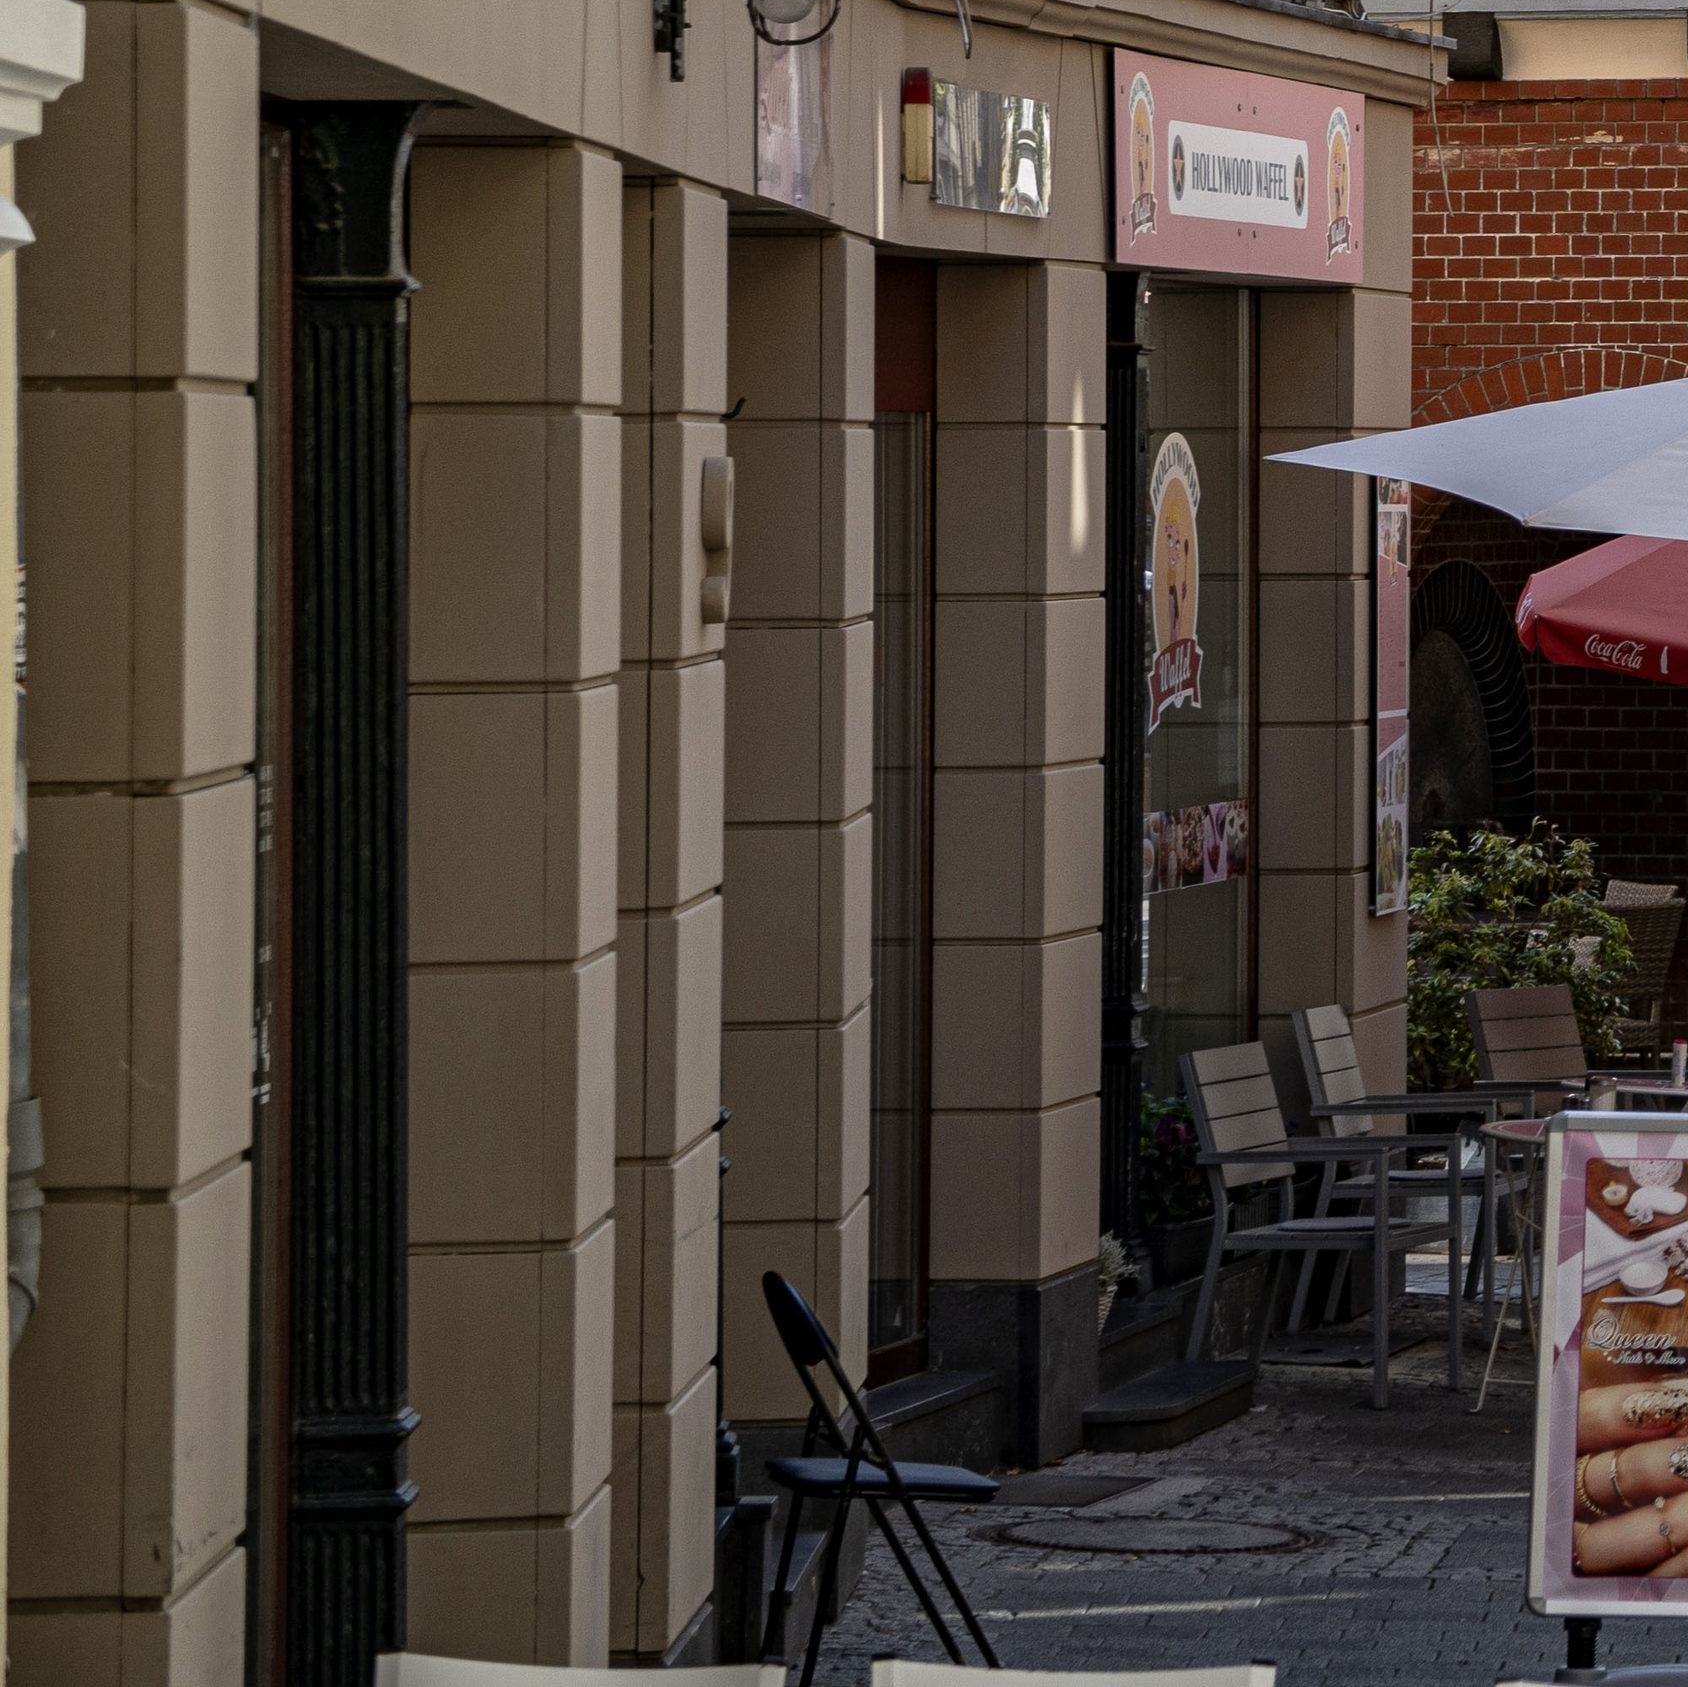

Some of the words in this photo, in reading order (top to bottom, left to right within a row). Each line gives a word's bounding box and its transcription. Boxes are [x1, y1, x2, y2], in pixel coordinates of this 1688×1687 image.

[1192, 151, 1253, 197] HOLLYWOOD
[1256, 161, 1289, 202] WAFFEL
[1584, 633, 1647, 670] Coca-Cola
[1587, 1315, 1677, 1351] Queen
